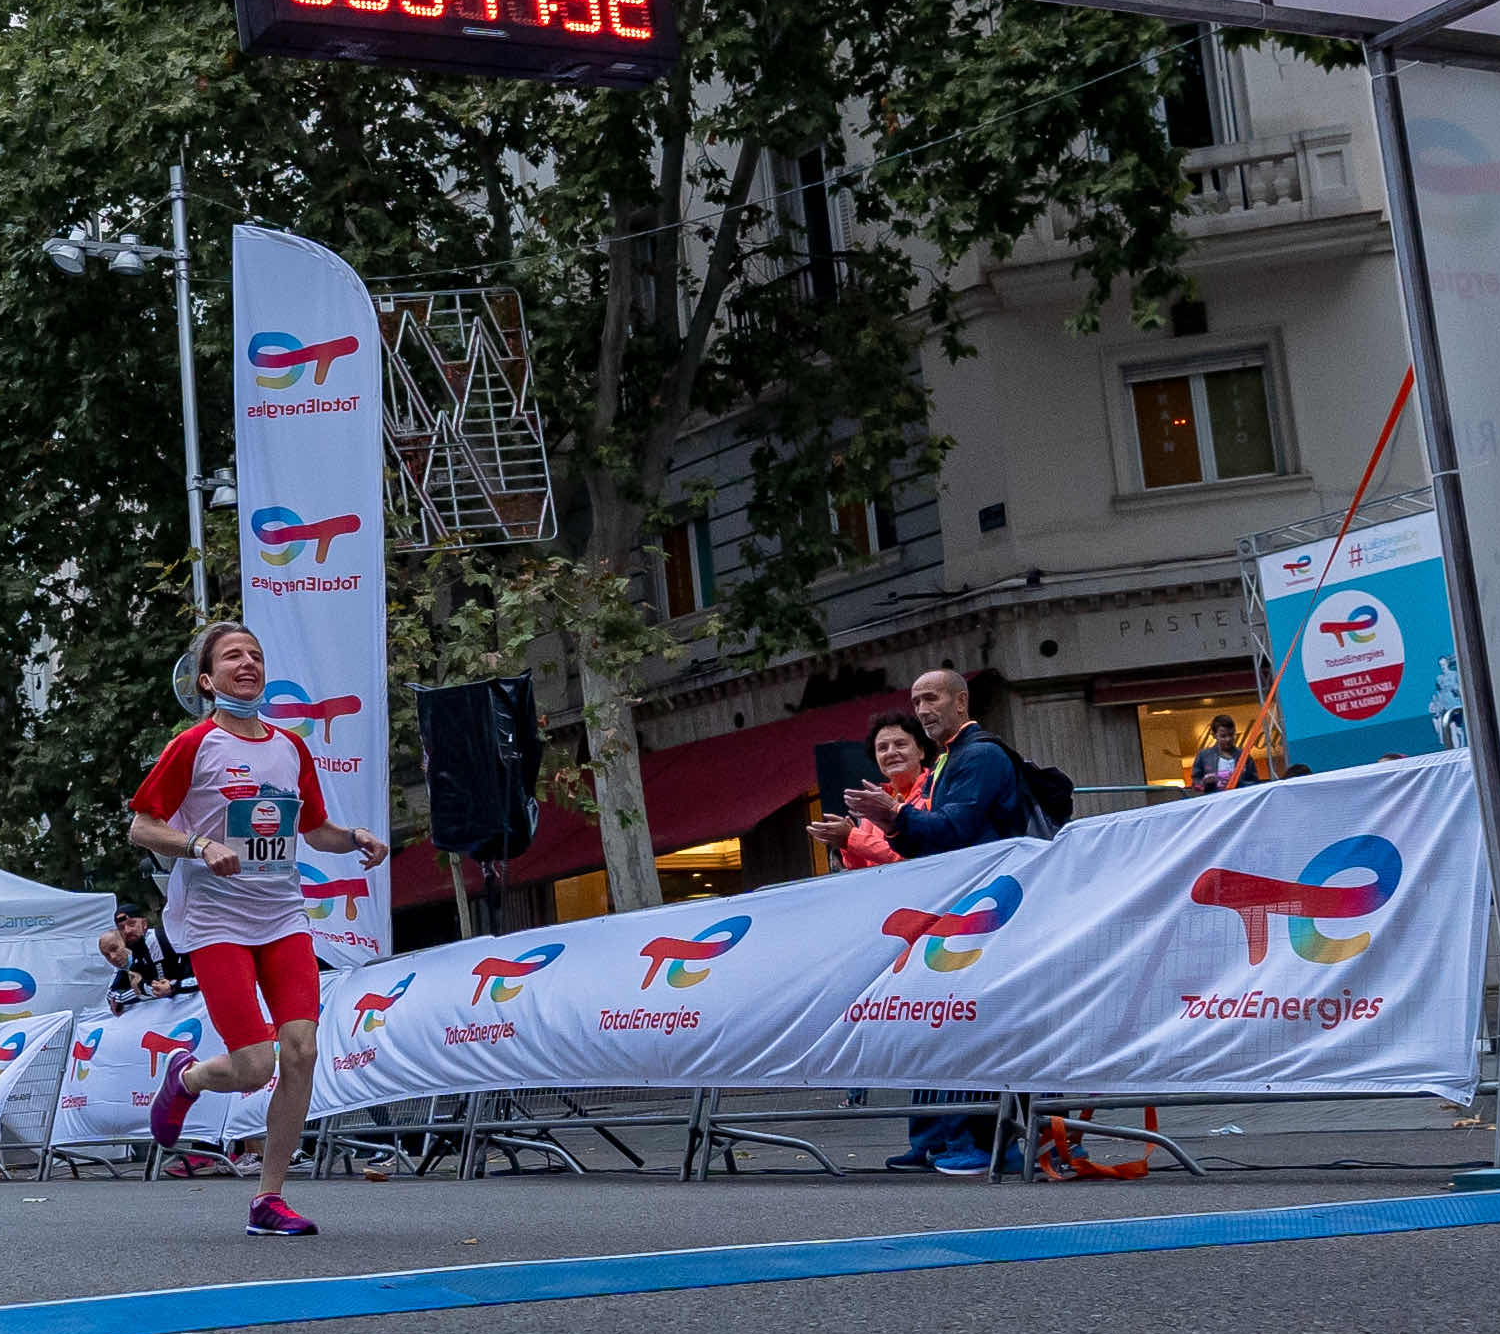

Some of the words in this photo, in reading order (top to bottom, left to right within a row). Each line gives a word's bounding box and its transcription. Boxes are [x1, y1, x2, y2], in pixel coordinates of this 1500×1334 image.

[245, 837, 286, 861] 1012
[598, 1004, 700, 1035] TotalEnergies
[1179, 987, 1383, 1031] TotalEnergies
[444, 1020, 516, 1046] TotalEnergies
